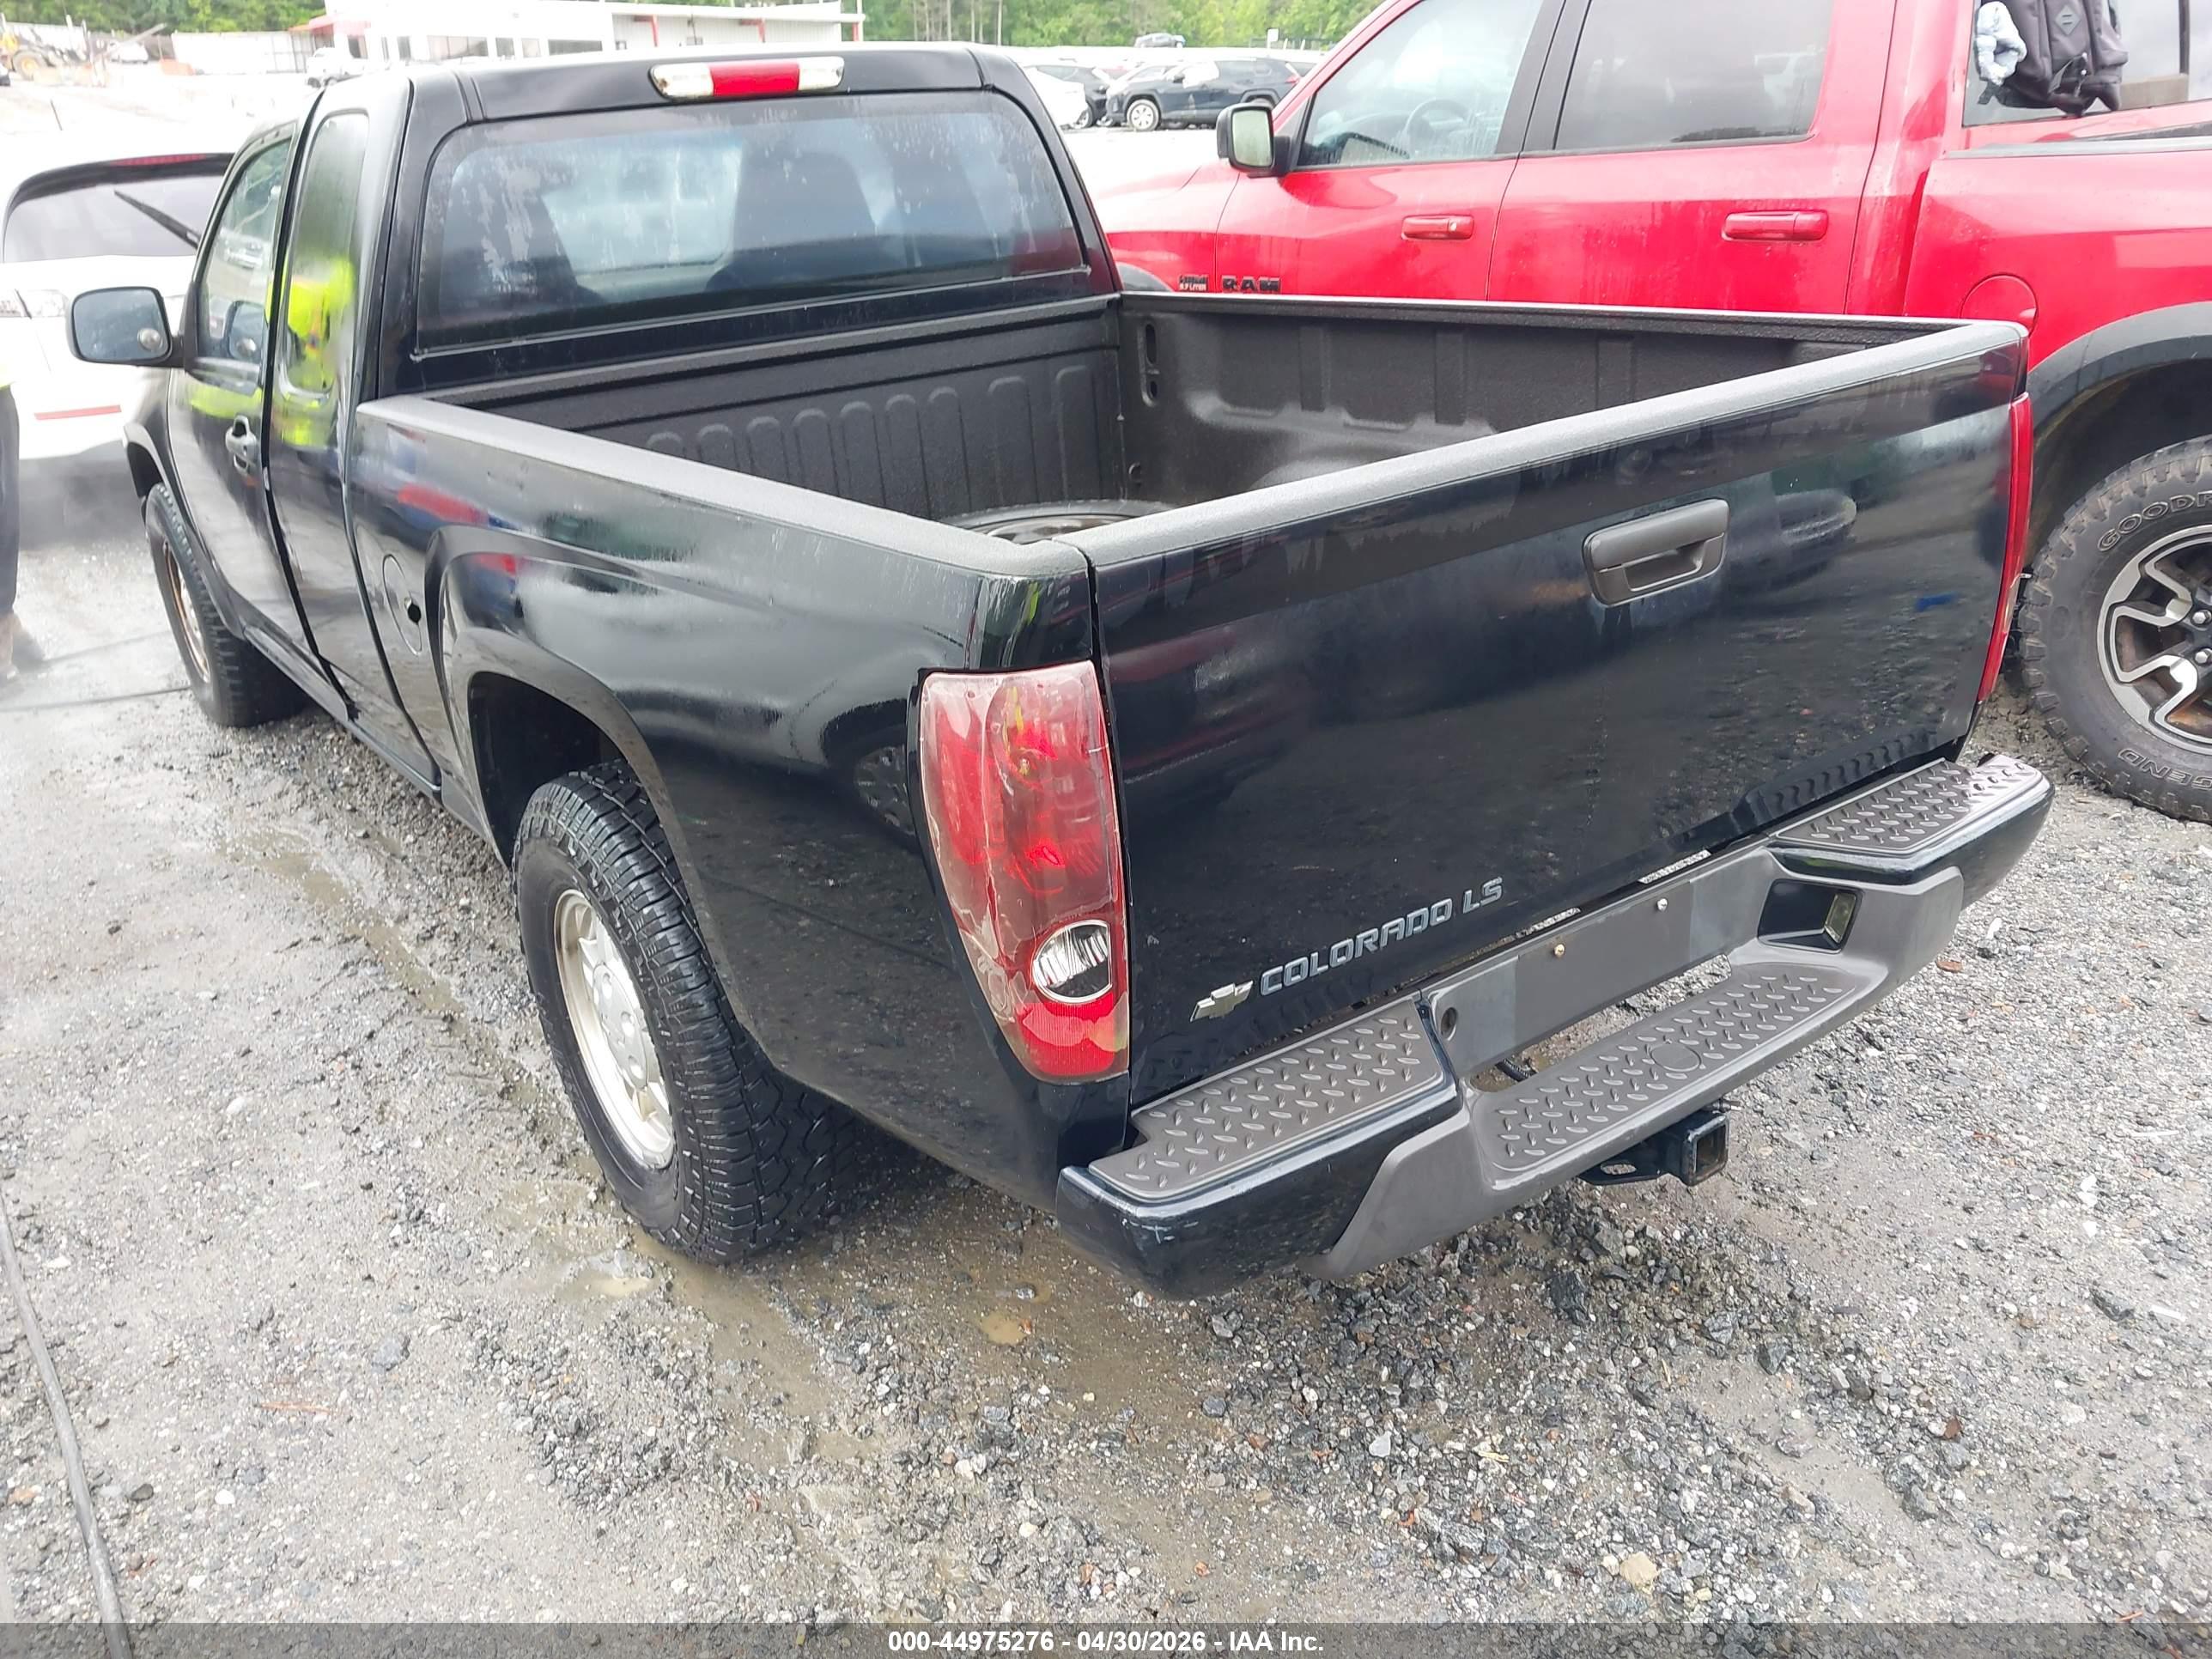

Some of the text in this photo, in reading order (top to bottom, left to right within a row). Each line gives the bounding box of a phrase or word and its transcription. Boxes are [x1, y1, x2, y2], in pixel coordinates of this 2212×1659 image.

[1222, 275, 1280, 292] RAM
[1260, 876, 1504, 996] COLORADO LS
